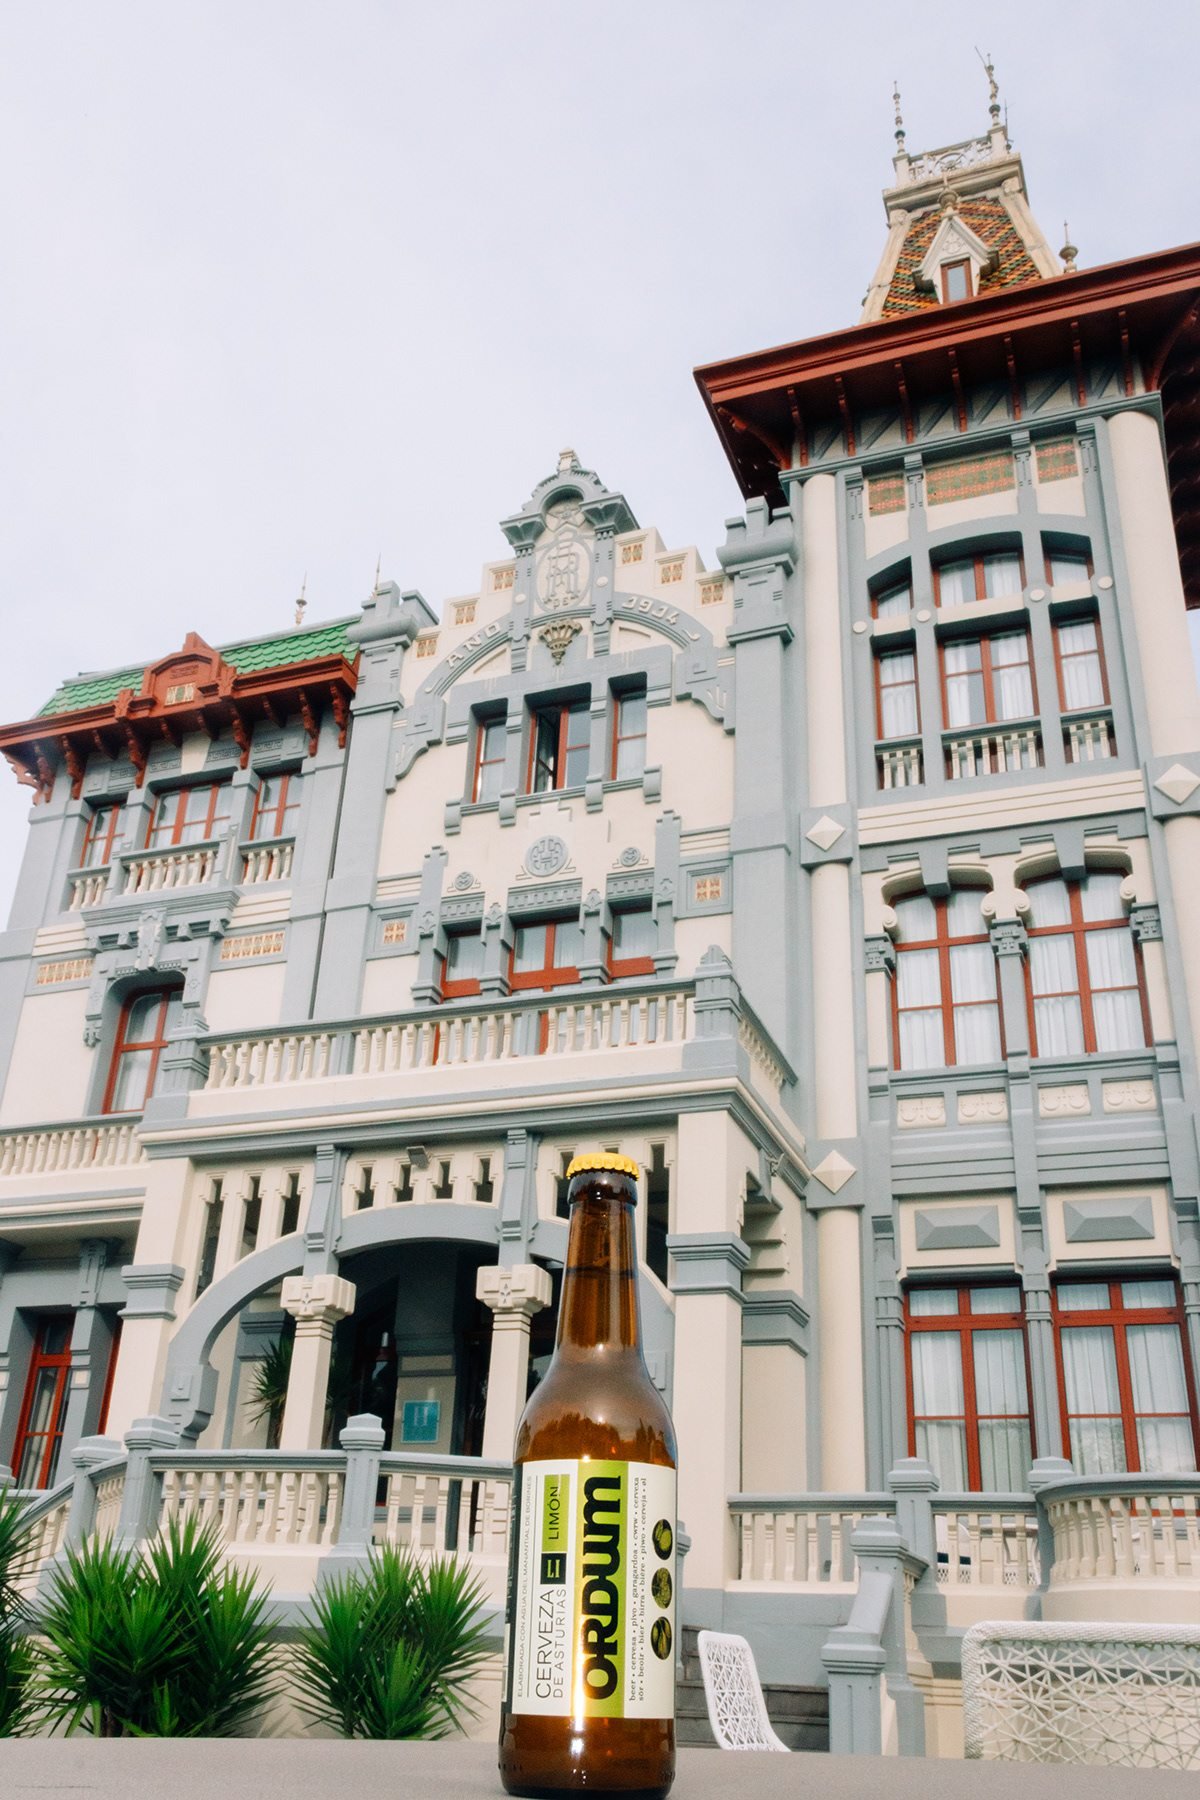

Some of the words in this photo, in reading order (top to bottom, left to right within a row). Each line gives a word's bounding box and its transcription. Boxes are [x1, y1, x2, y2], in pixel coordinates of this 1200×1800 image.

[547, 1486, 560, 1540] LIMÓN
[536, 1590, 554, 1698] CERVEZA
[555, 1589, 566, 1671] ASTURIAS
[518, 1643, 526, 1697] ELABORADA
[553, 1677, 563, 1698] DE
